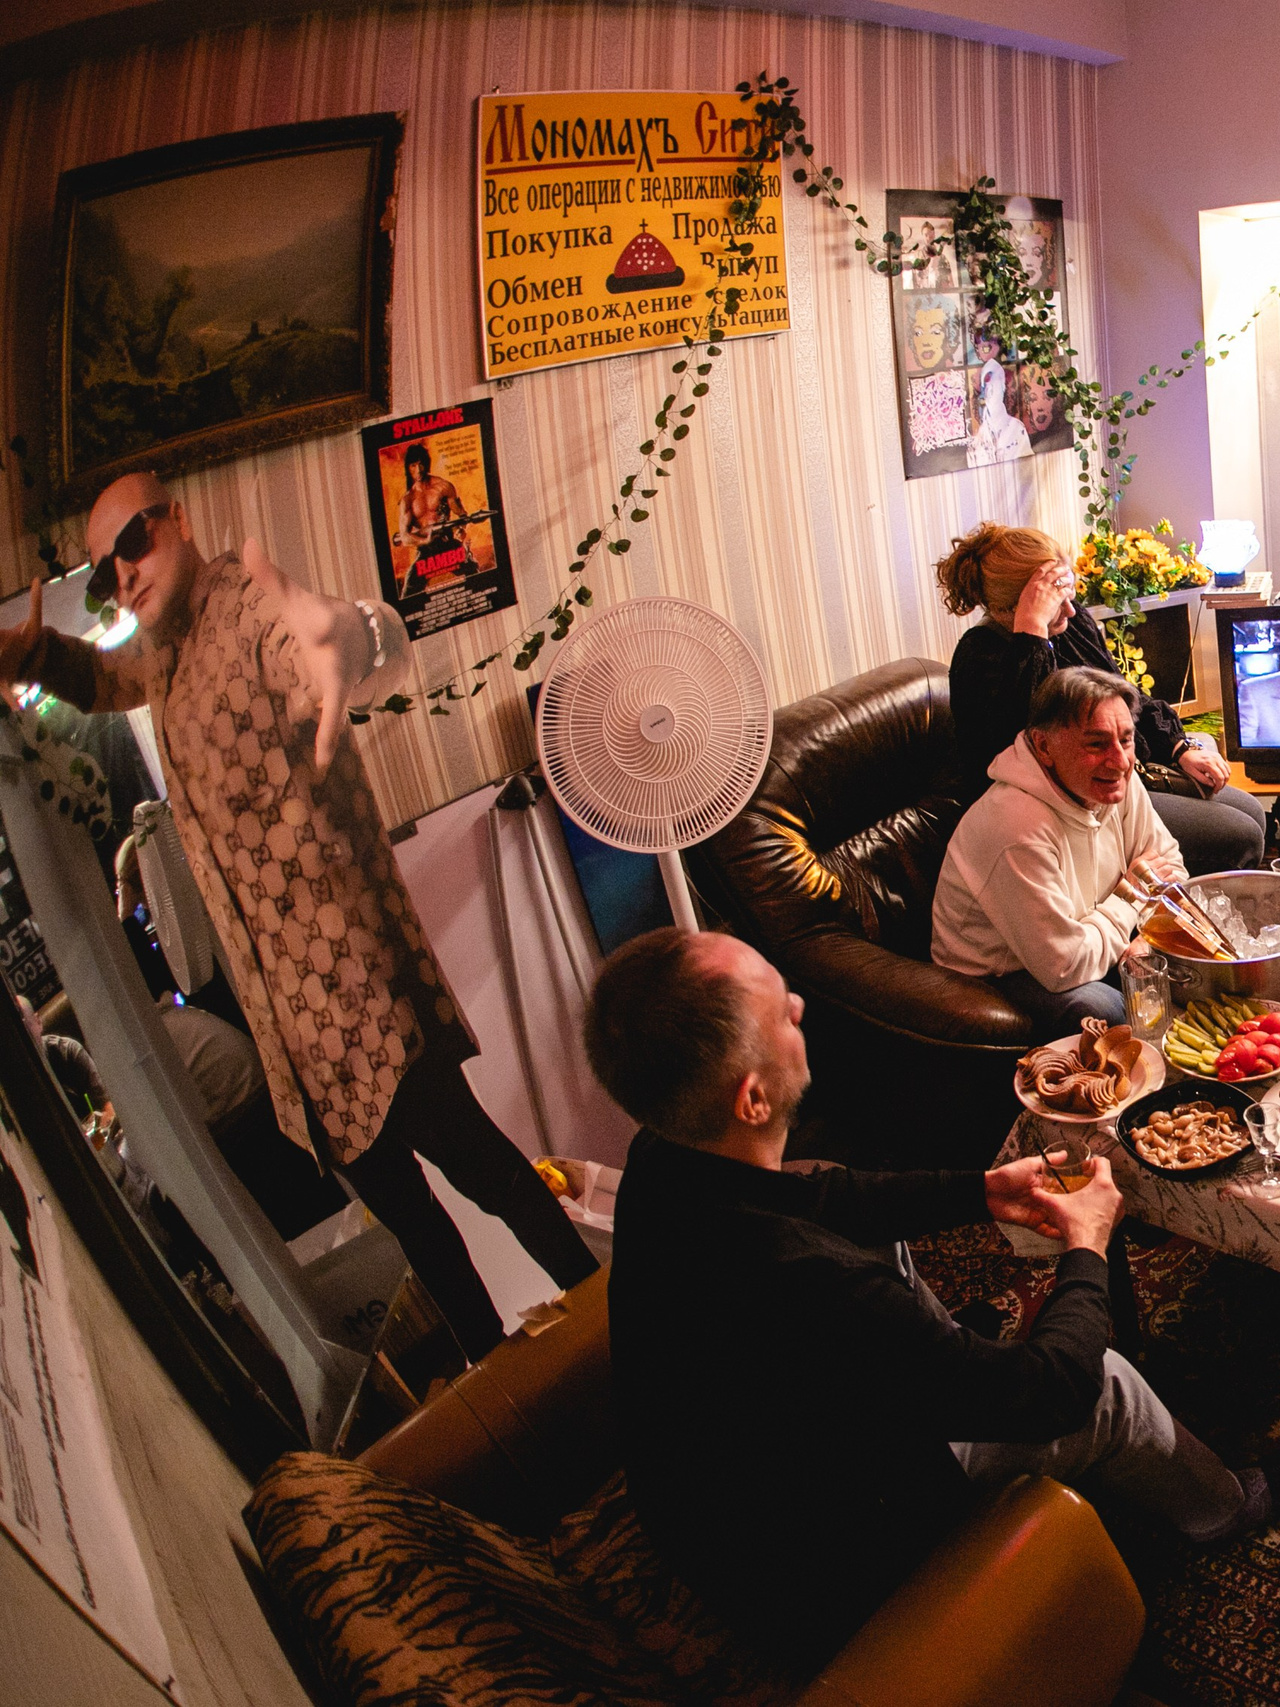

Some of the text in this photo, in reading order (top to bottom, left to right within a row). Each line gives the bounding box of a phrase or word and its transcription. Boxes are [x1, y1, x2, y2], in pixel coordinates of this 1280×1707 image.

[485, 103, 679, 172] Мономахъ
[484, 178, 519, 217] Все
[527, 177, 622, 217] операции
[486, 212, 778, 259] Покупка Продажа
[487, 275, 583, 309] Обмен
[487, 285, 788, 338] Сопровождение селок
[489, 325, 635, 366] Бесплатные
[392, 408, 464, 439] STALLONE
[416, 546, 467, 577] RAMBO
